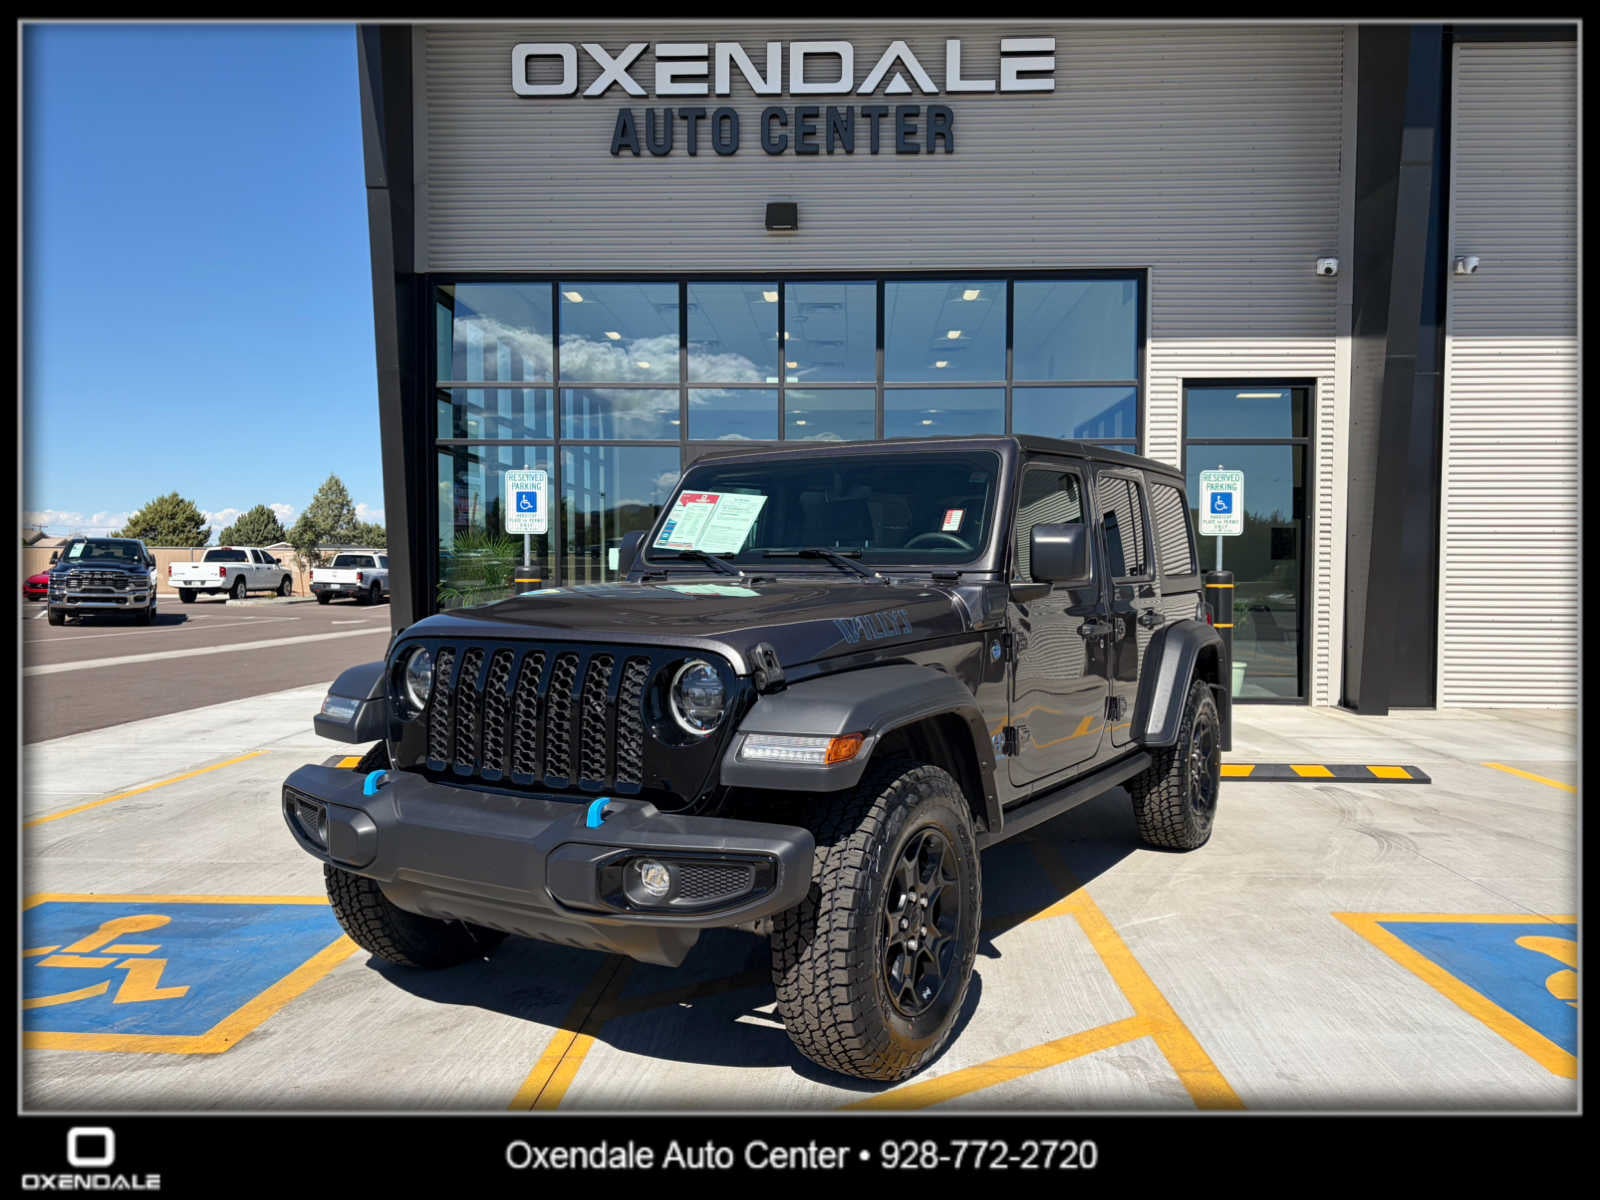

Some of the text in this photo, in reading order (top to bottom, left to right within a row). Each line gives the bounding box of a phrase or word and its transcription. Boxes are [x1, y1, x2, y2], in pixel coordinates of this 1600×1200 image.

[511, 37, 1057, 98] OXENDALE
[610, 104, 955, 157] AUTO CENTER
[508, 473, 545, 481] RESERVED
[1203, 474, 1241, 482] RESERVED
[511, 482, 542, 491] PARKING
[1206, 483, 1238, 491] PARKING
